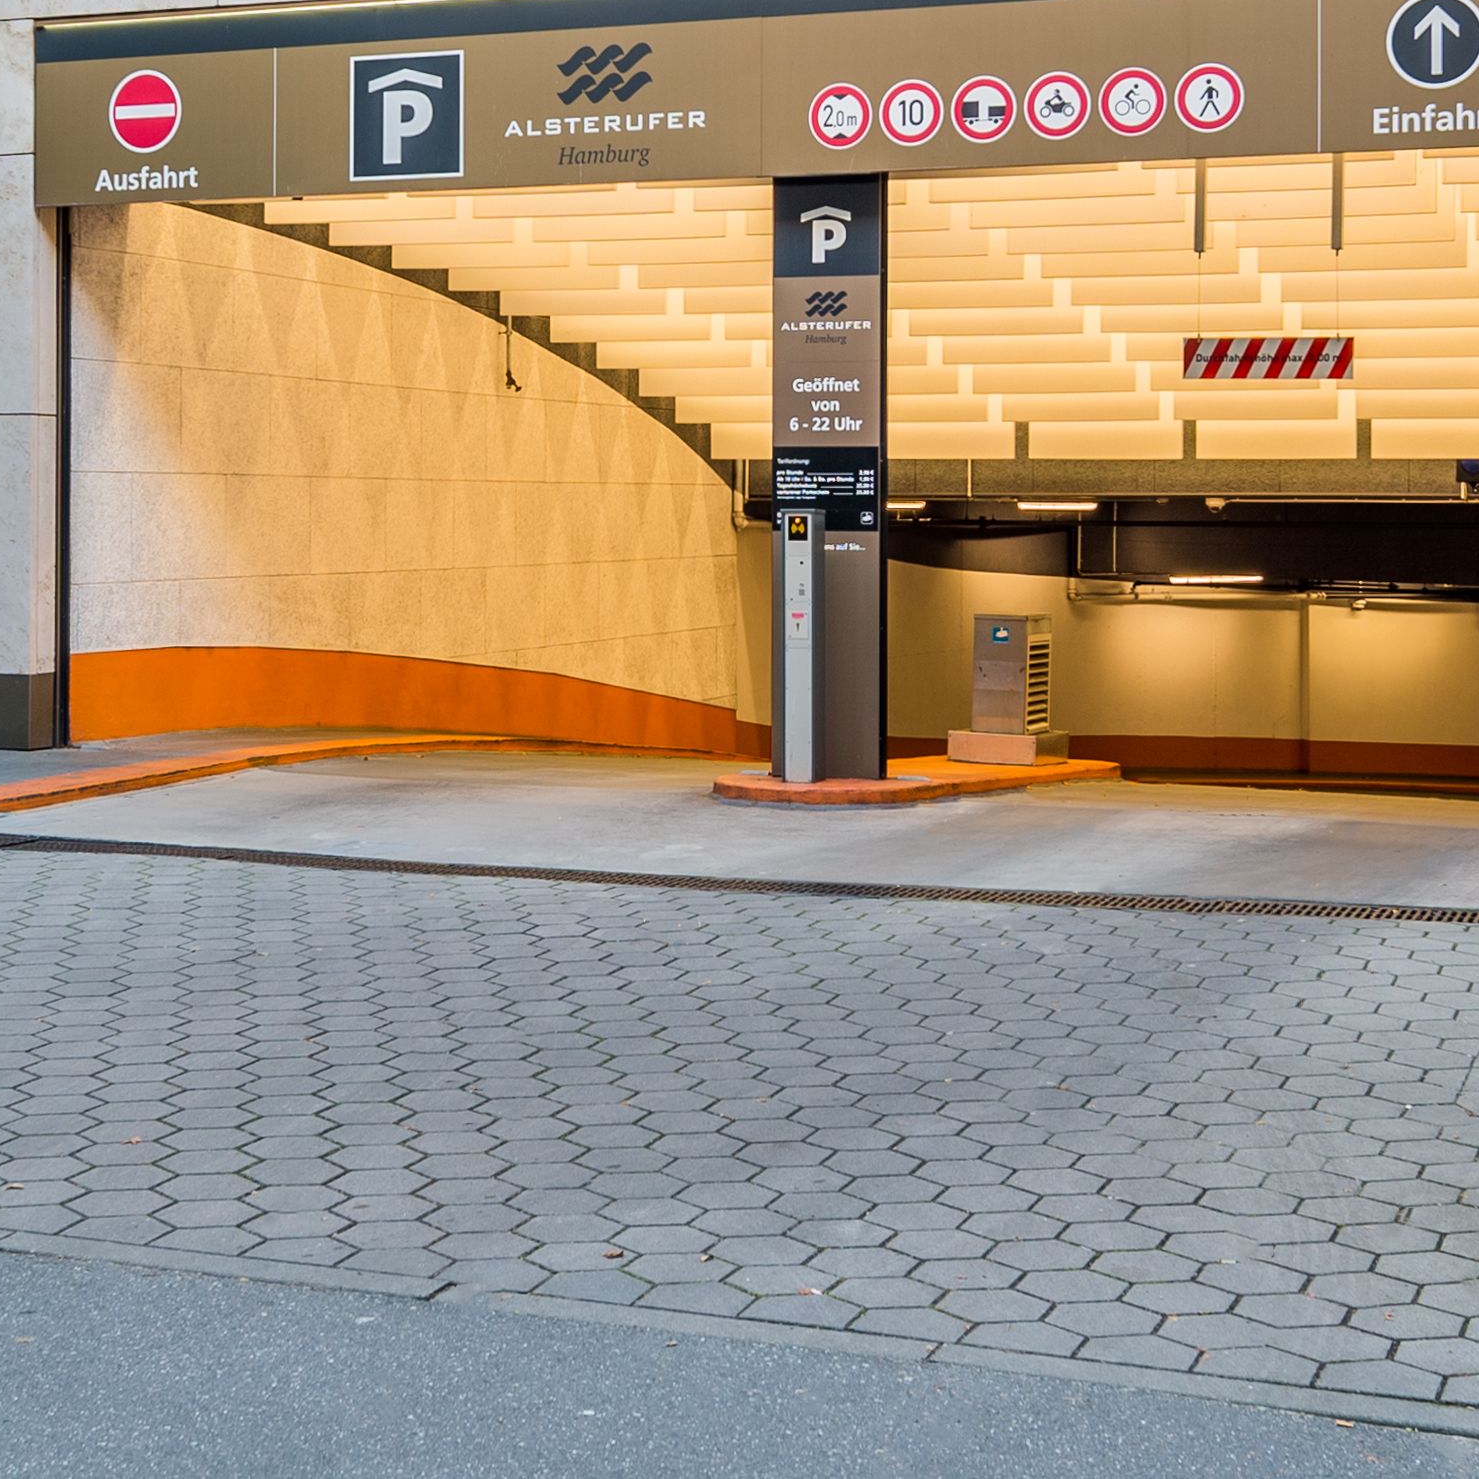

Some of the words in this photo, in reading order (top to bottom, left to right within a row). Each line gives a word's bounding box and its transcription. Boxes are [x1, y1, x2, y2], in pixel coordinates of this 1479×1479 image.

[504, 110, 707, 138] ALSTERUFER
[898, 99, 924, 126] 10
[382, 89, 434, 165] P
[558, 144, 650, 167] Hamburg
[94, 165, 199, 192] Ausfahrt
[812, 219, 847, 264] P
[781, 321, 872, 331] ALSTERUFER
[805, 334, 848, 345] Hamburg
[792, 377, 860, 392] Geöffnet
[811, 400, 840, 412] von
[789, 417, 799, 431] 6
[811, 417, 830, 431] 22
[834, 416, 863, 431] Uhr
